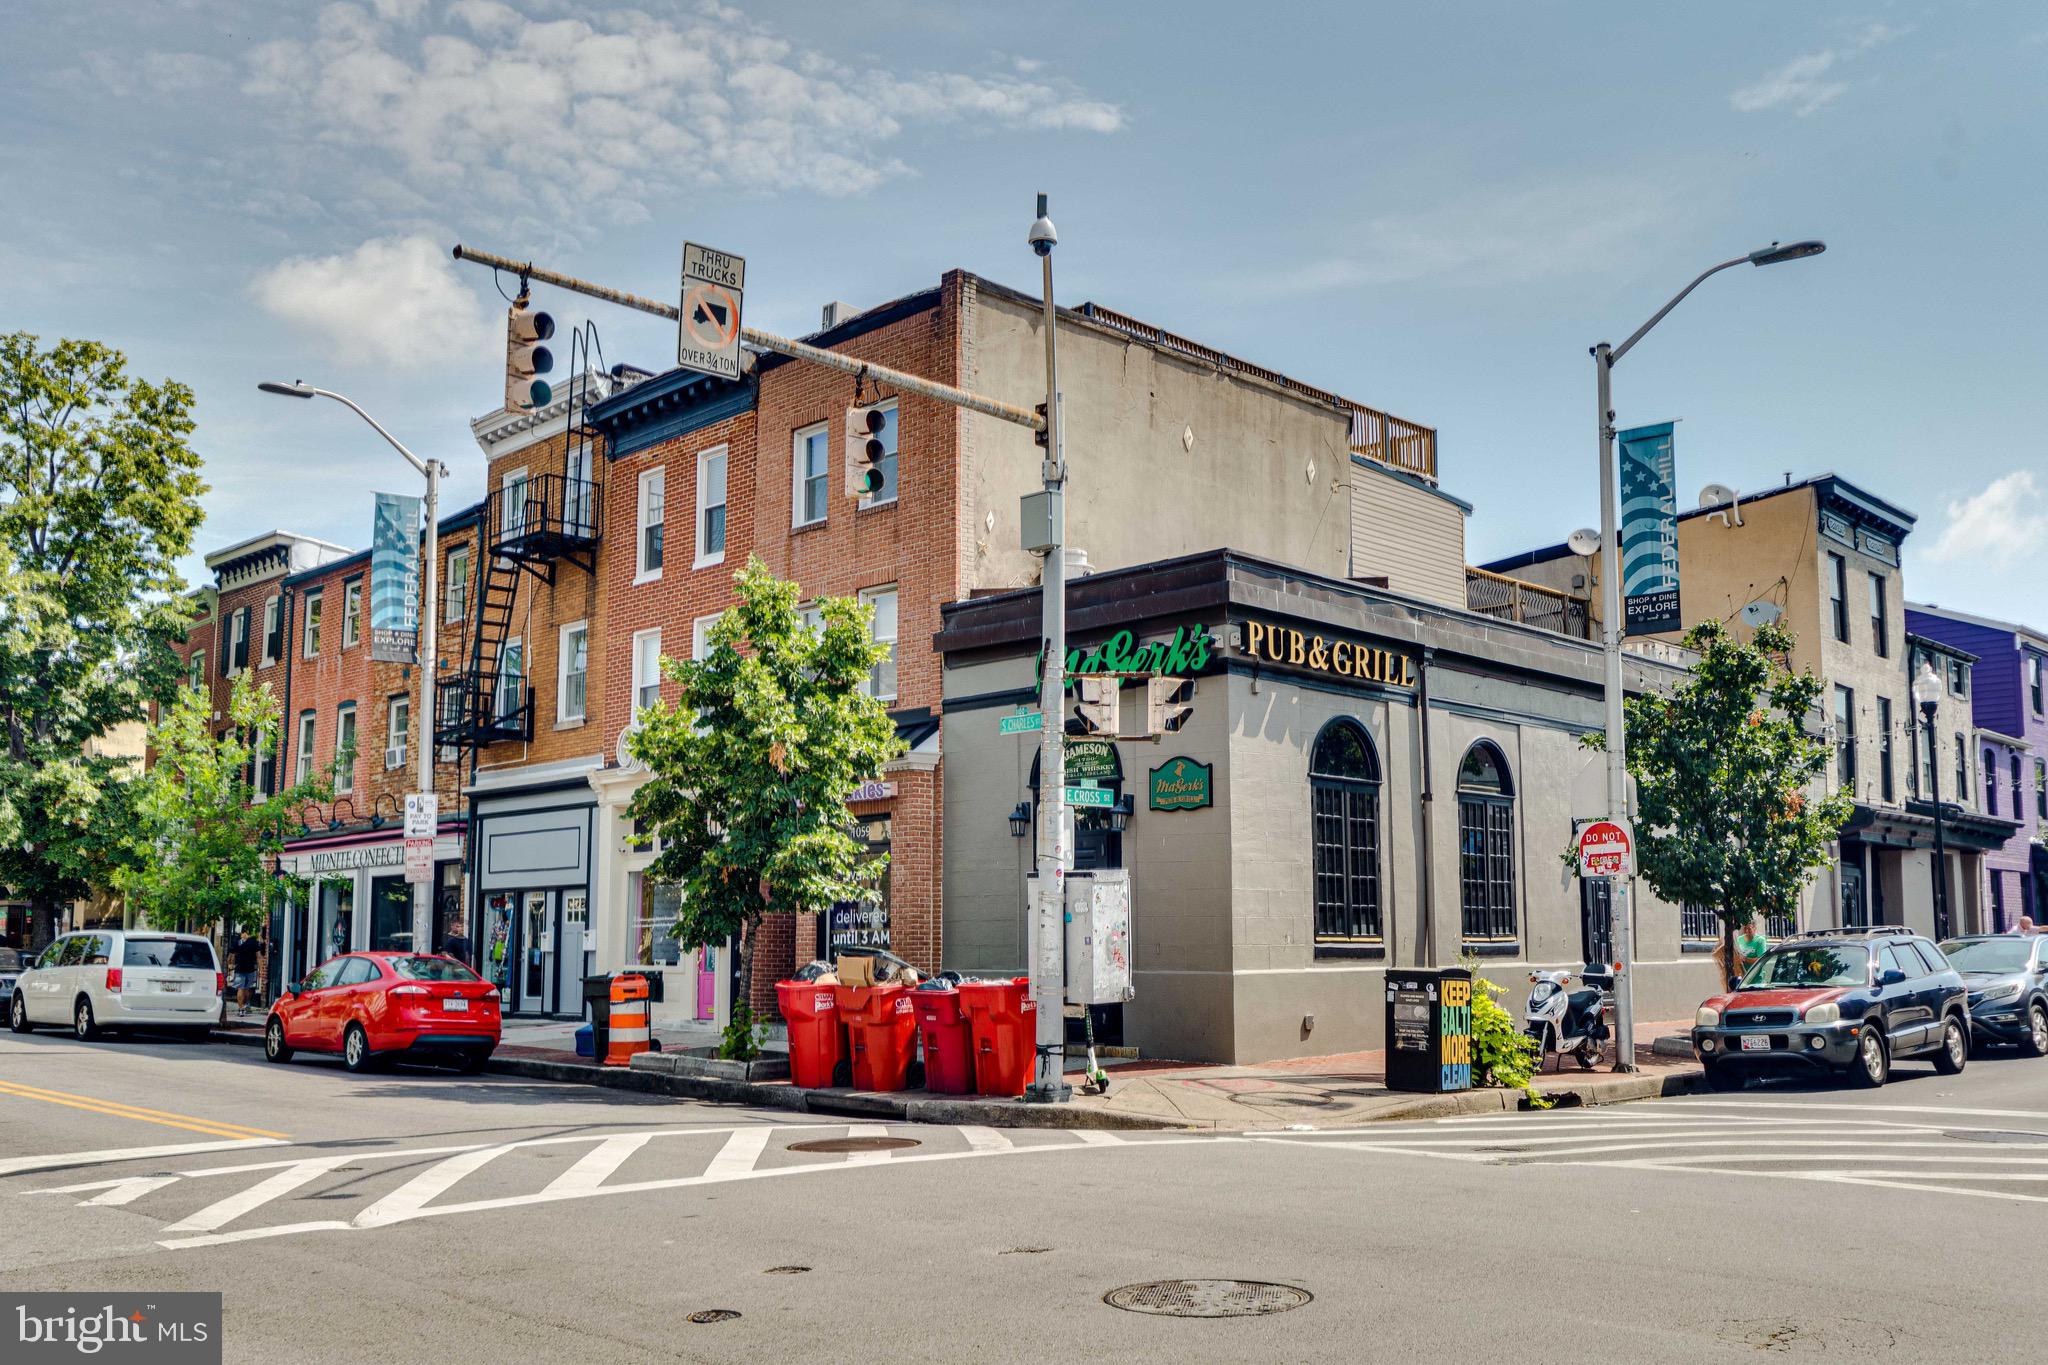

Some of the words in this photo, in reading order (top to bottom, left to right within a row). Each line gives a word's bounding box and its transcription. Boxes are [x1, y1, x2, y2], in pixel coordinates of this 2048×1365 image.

[700, 249, 731, 269] THRU
[692, 261, 736, 285] TRUCKS
[681, 347, 706, 364] OVER
[719, 356, 737, 373] TON
[1657, 439, 1672, 482] HILL
[405, 509, 418, 547] HILL
[1660, 484, 1678, 589] FEDERAL
[403, 550, 419, 629] FEDERAL
[1627, 596, 1650, 606] SHOP
[1658, 592, 1678, 602] DINE
[1627, 600, 1679, 616] EXPLORE
[374, 629, 394, 637] SHOP
[374, 636, 416, 647] EXPLORE
[1064, 744, 1108, 760] JAMESON
[1082, 764, 1115, 772] WHISKEY
[1074, 790, 1101, 803] CROSS
[407, 839, 432, 848] PARKING
[1586, 834, 1598, 842] DO
[1602, 832, 1620, 841] NOT
[311, 851, 352, 872] MIDNITE
[352, 845, 405, 868] CONFECTI
[836, 908, 887, 924] delivered
[833, 930, 858, 945] until
[861, 930, 868, 944] 3
[871, 929, 890, 945] AM
[1441, 981, 1471, 1006] KEEP
[1441, 1006, 1471, 1035] BALTI
[1441, 1035, 1471, 1065] MORE
[1441, 1064, 1471, 1090] CLEAN
